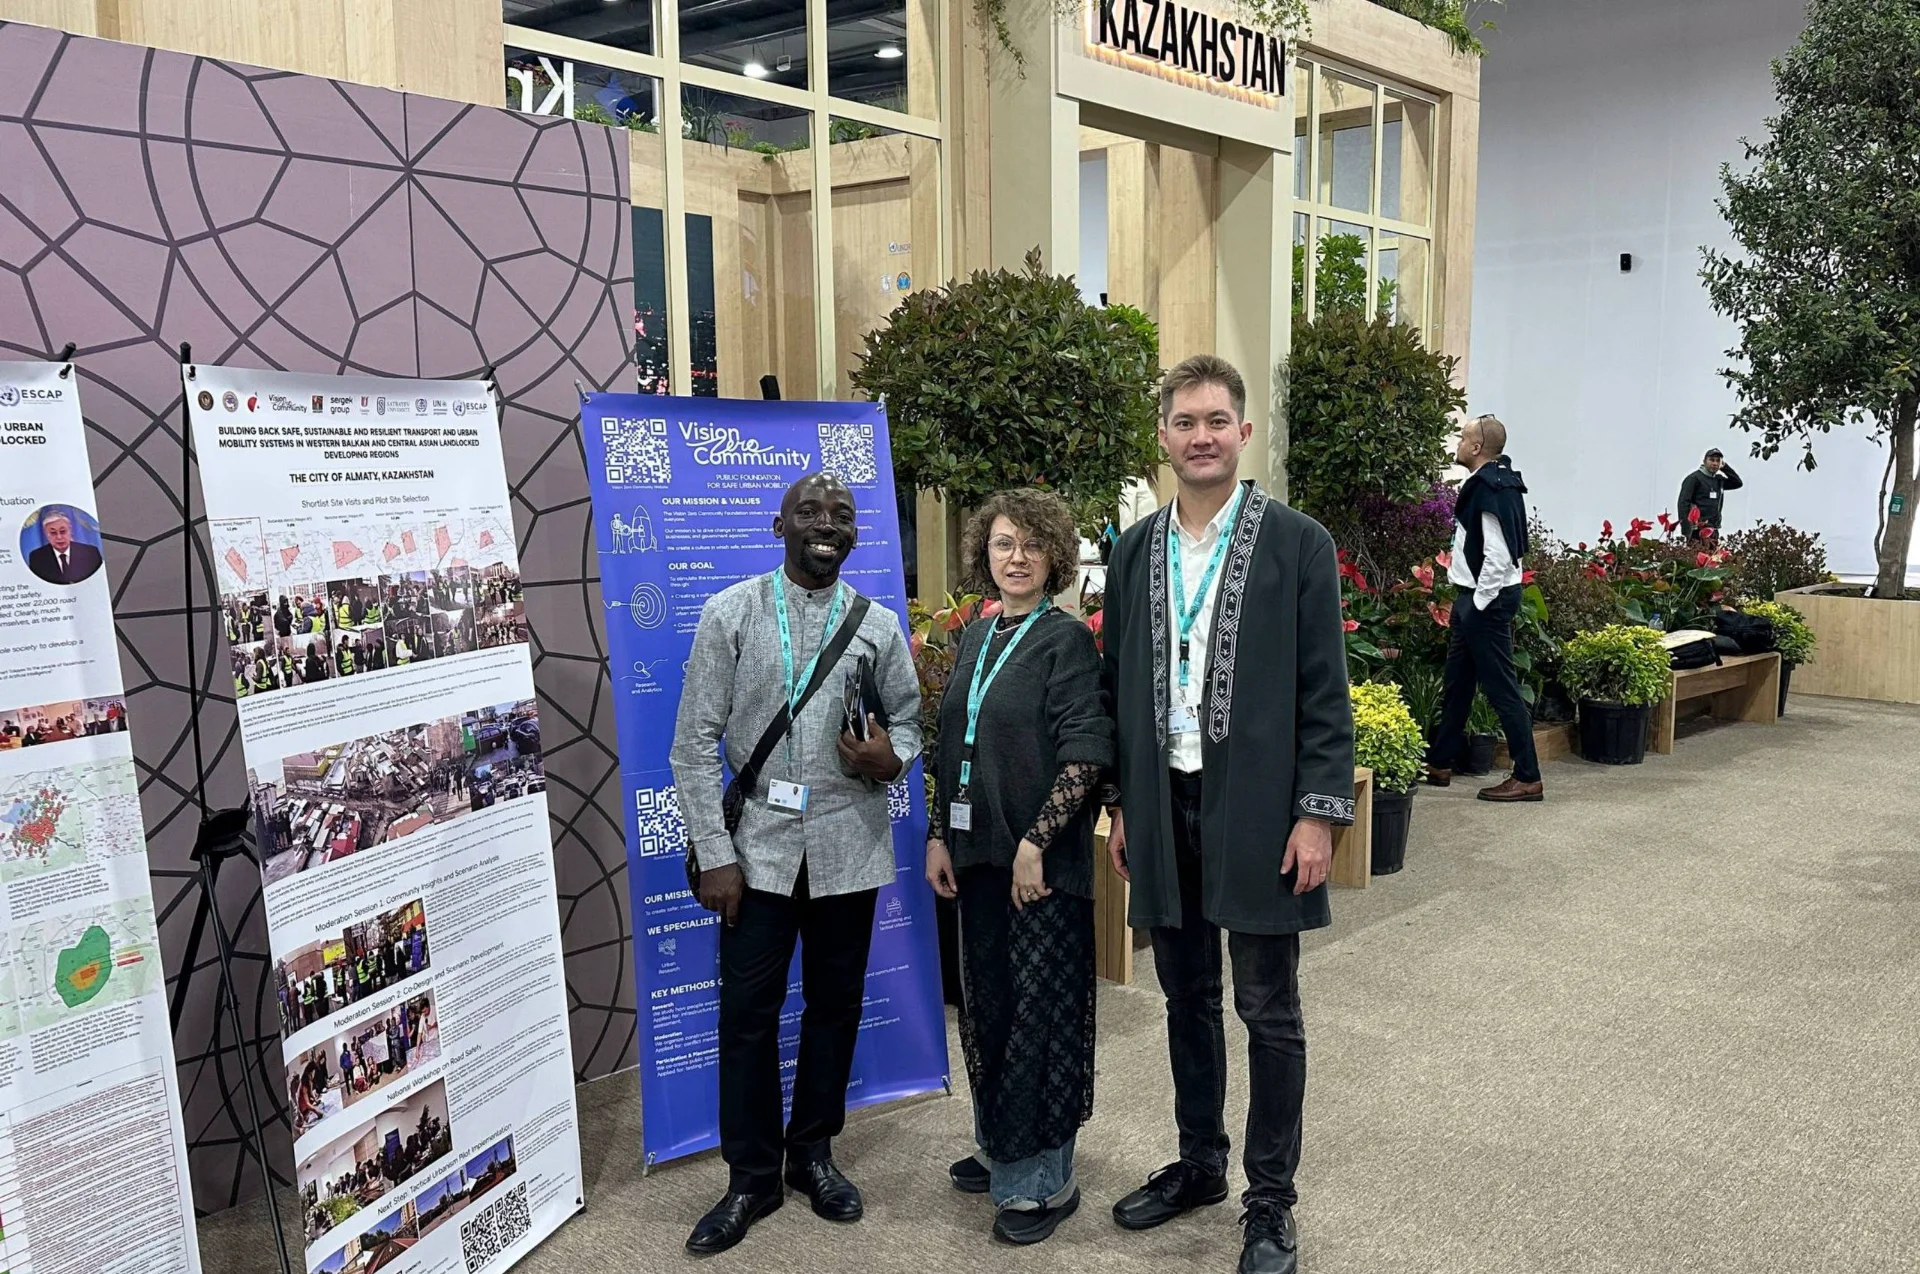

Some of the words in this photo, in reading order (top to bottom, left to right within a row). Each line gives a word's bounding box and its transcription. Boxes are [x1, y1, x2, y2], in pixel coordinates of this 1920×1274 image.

[1099, 0, 1286, 96] KAZAKHSTAN
[21, 389, 63, 399] ESCAP
[466, 402, 488, 410] ESCAP
[4, 422, 44, 432] URBAN
[218, 426, 257, 435] BUILDING
[258, 427, 280, 435] BACK
[281, 427, 303, 437] SAFE,
[304, 427, 352, 436] SUSTAINABLE
[353, 428, 369, 436] AND
[370, 428, 401, 436] RESILIENT
[403, 428, 441, 436] TRANSPORT
[443, 428, 456, 436] AND
[678, 421, 740, 441] Vision
[0, 435, 46, 445] LOCKED
[219, 439, 258, 448] MOBILITY
[260, 439, 295, 447] SYSTEMS
[296, 439, 304, 447] IN
[305, 439, 341, 447] WESTERN
[342, 439, 370, 447] BALKAN
[371, 439, 386, 447] AND
[388, 439, 417, 447] CENTRAL
[686, 434, 774, 454] Zero
[324, 450, 368, 459] DEVELOPING
[370, 450, 400, 459] REGIONS
[693, 446, 811, 470] Community
[289, 473, 307, 483] THE
[309, 472, 329, 482] CITY
[331, 472, 343, 481] OF
[345, 471, 381, 482] ALMATY,
[382, 470, 435, 480] KAZAKHSTAN
[301, 500, 329, 508] Shortlist
[330, 499, 343, 507] Site
[344, 498, 361, 506] Visits
[362, 497, 374, 505] and
[389, 496, 401, 504] Site
[402, 495, 430, 503] Selection
[662, 497, 681, 505] OUR
[683, 497, 719, 505] MISSION
[721, 497, 727, 505] &
[729, 497, 761, 505] VALUES
[668, 562, 688, 570] OUR
[690, 561, 715, 570] GOAL
[48, 639, 78, 649] develop
[315, 913, 352, 932] Moderation
[353, 903, 378, 918] Session
[386, 887, 420, 905] Community
[421, 876, 443, 891] Insights
[443, 873, 454, 883] and
[455, 864, 478, 877] Scenario
[479, 855, 500, 869] Analysis
[644, 894, 663, 904] OUR
[647, 926, 661, 936] WE
[663, 916, 714, 933] SPECIALIZE
[333, 1005, 371, 1029] Moderation
[371, 994, 395, 1010] Session
[403, 976, 434, 995] Co-Design
[434, 969, 445, 981] and
[445, 959, 470, 975] Scenario
[470, 942, 505, 964] Development
[651, 988, 669, 1000] KEY
[670, 979, 716, 996] METHODS
[386, 1083, 411, 1102] National
[411, 1066, 441, 1088] Workshop
[442, 1062, 450, 1071] on
[450, 1052, 464, 1065] Road
[465, 1044, 483, 1058] Safety
[377, 1200, 393, 1215] Next
[409, 1173, 432, 1193] Tactical
[432, 1157, 459, 1179] Urbanism
[459, 1147, 471, 1160] Pilot
[471, 1123, 512, 1153] Implementation
